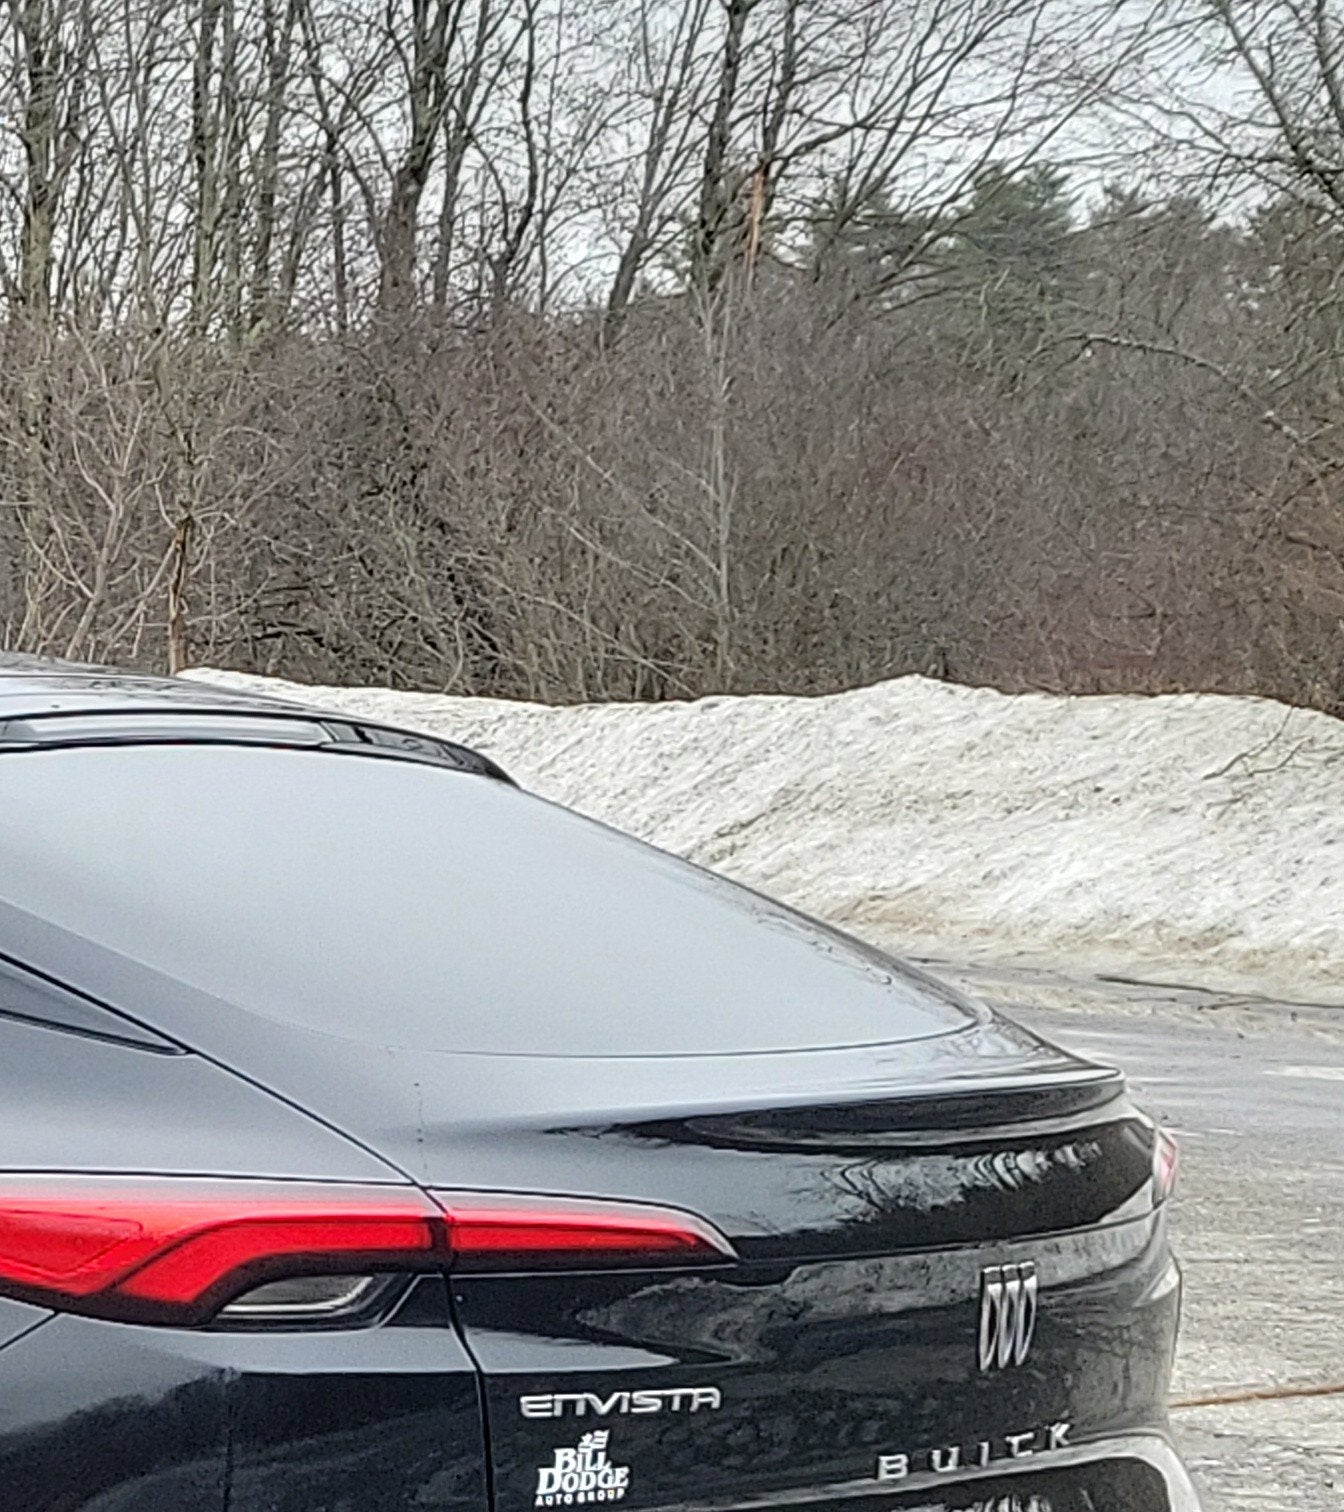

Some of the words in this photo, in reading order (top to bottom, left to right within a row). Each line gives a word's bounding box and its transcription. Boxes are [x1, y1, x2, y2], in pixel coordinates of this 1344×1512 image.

[520, 1387, 721, 1418] ENVISTA
[554, 1447, 611, 1473] BILL
[877, 1423, 1072, 1481] BUICK
[536, 1466, 630, 1496] DODGE
[535, 1494, 573, 1507] AUTO
[577, 1488, 625, 1504] GROUP
